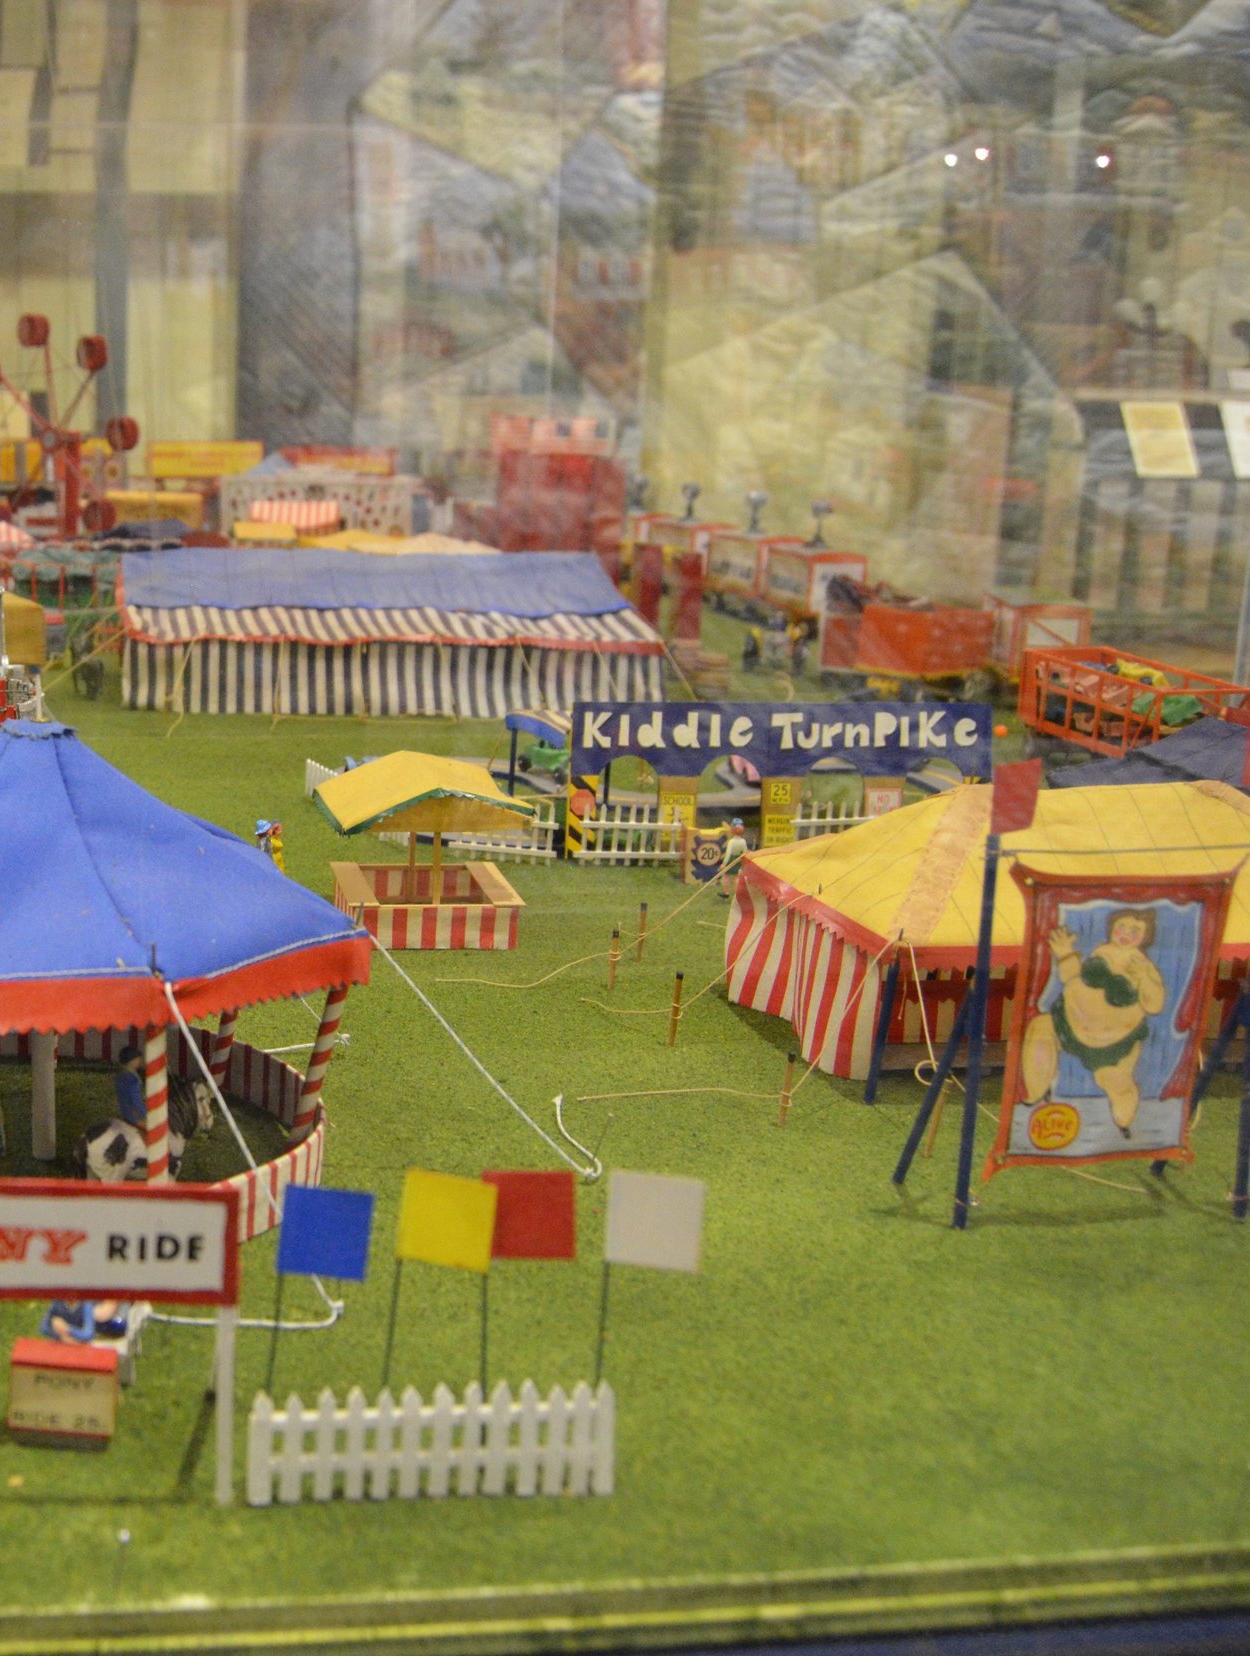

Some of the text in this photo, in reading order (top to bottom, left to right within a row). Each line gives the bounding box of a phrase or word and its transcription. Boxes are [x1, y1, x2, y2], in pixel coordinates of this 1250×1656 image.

[773, 785, 788, 797] 25
[662, 795, 694, 806] SCHOOL
[107, 1233, 203, 1262] RIDE
